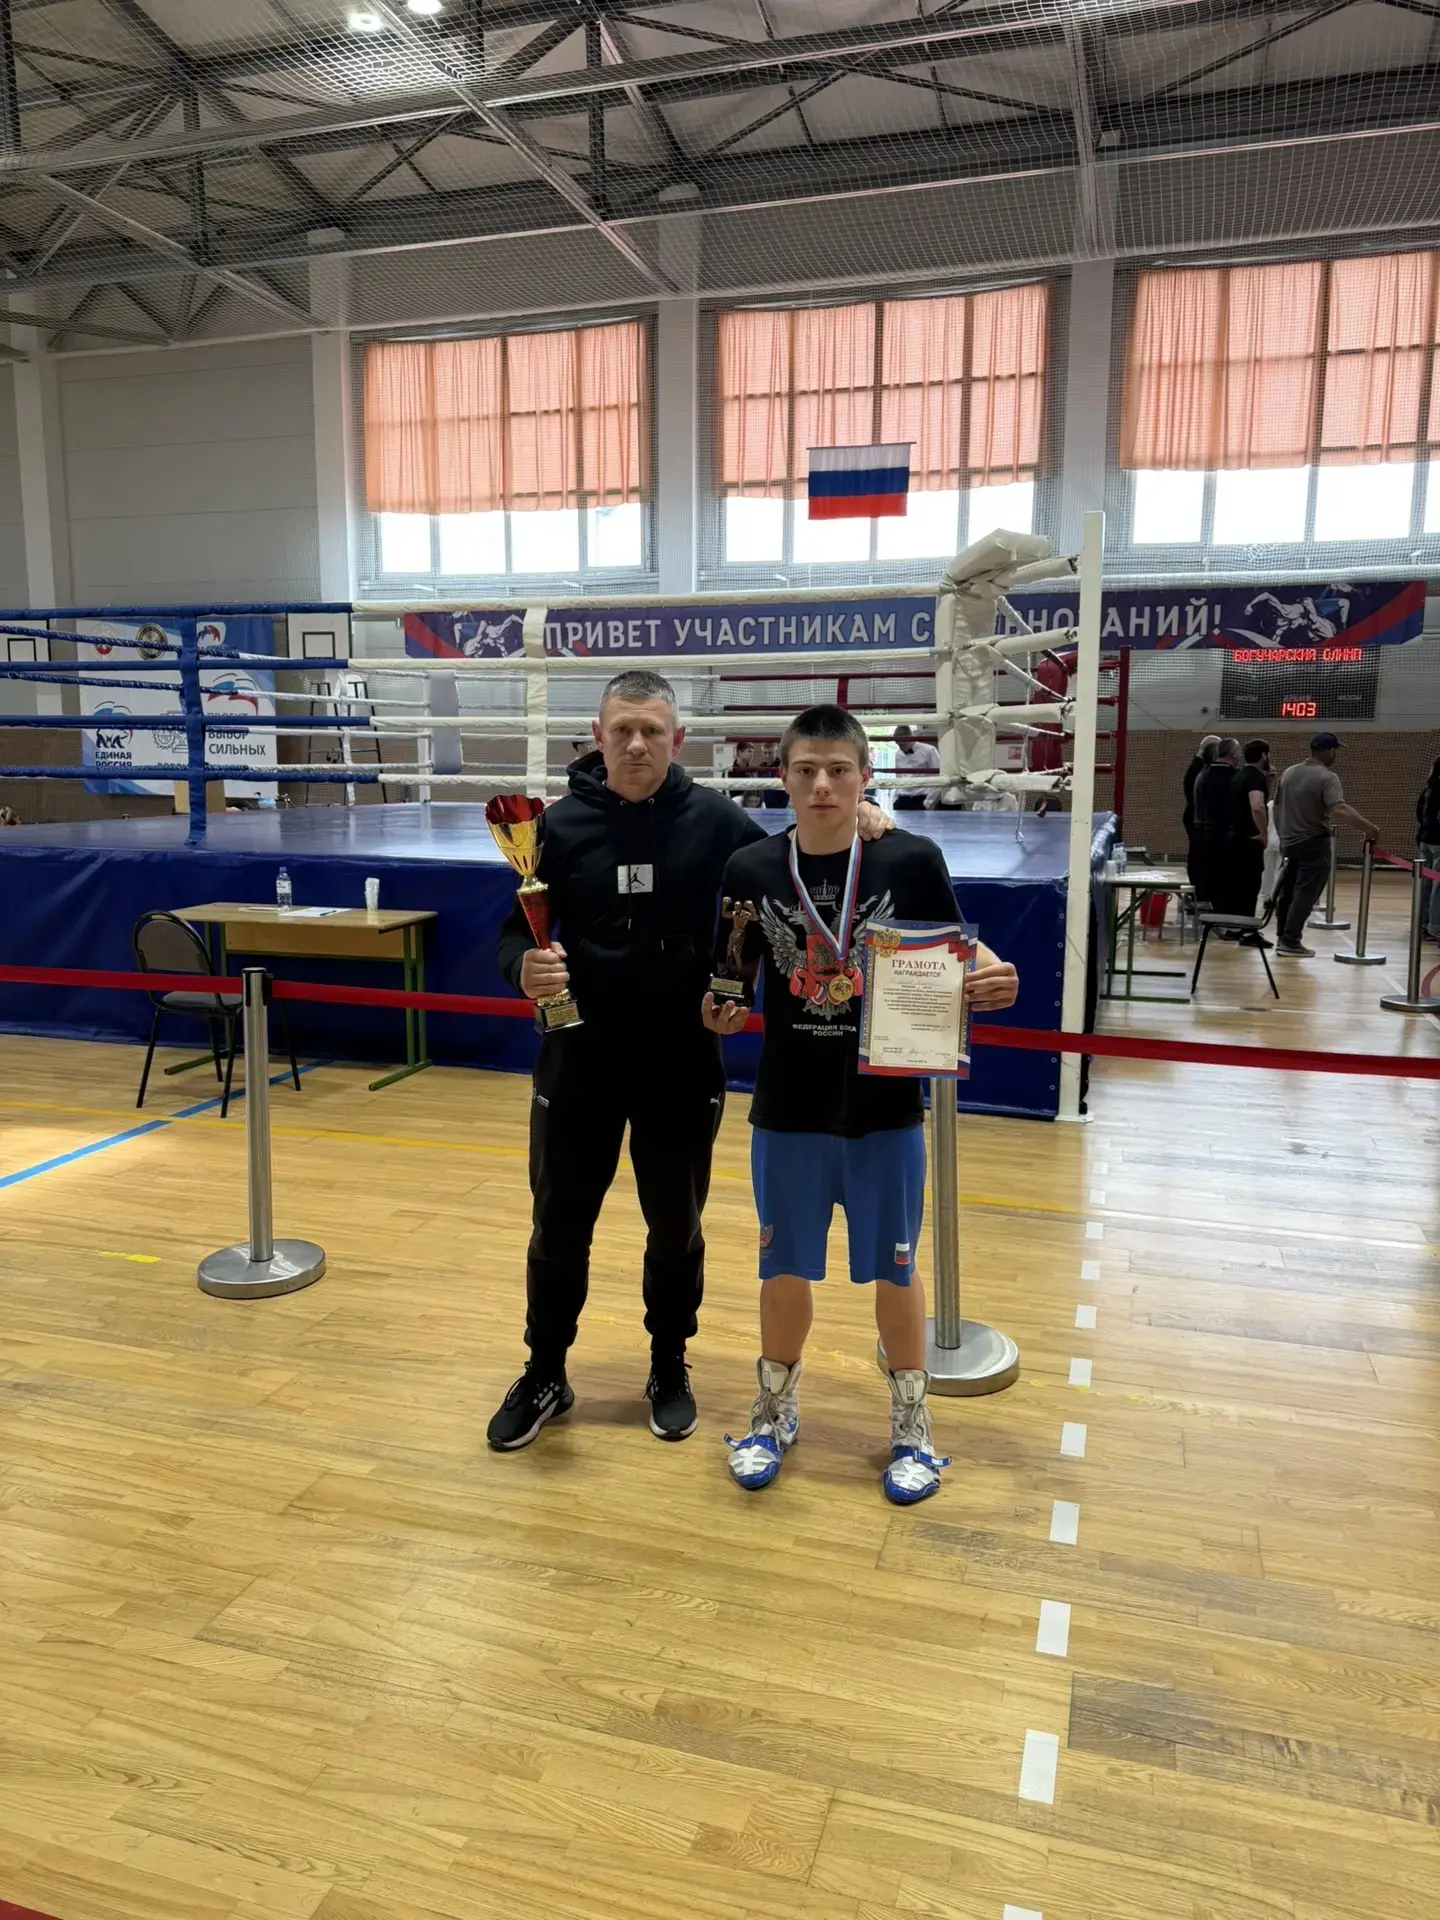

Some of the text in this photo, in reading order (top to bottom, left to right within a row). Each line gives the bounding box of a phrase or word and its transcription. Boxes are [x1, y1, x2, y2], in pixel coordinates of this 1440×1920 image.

[544, 619, 661, 650] ПРИВЕТ
[674, 612, 897, 647] УЧАСТНИКАМ
[1322, 648, 1362, 661] ОЛИМП
[1282, 702, 1316, 716] 1403
[208, 743, 266, 756] СИЛЬНЫХ
[95, 752, 132, 760] ЕДИНАЯ
[891, 959, 947, 971] ГРАМОТА
[893, 969, 942, 978] НАГРАЖДАЕТСЯ
[792, 1023, 838, 1031] ФЕДЕРАЦИЯ
